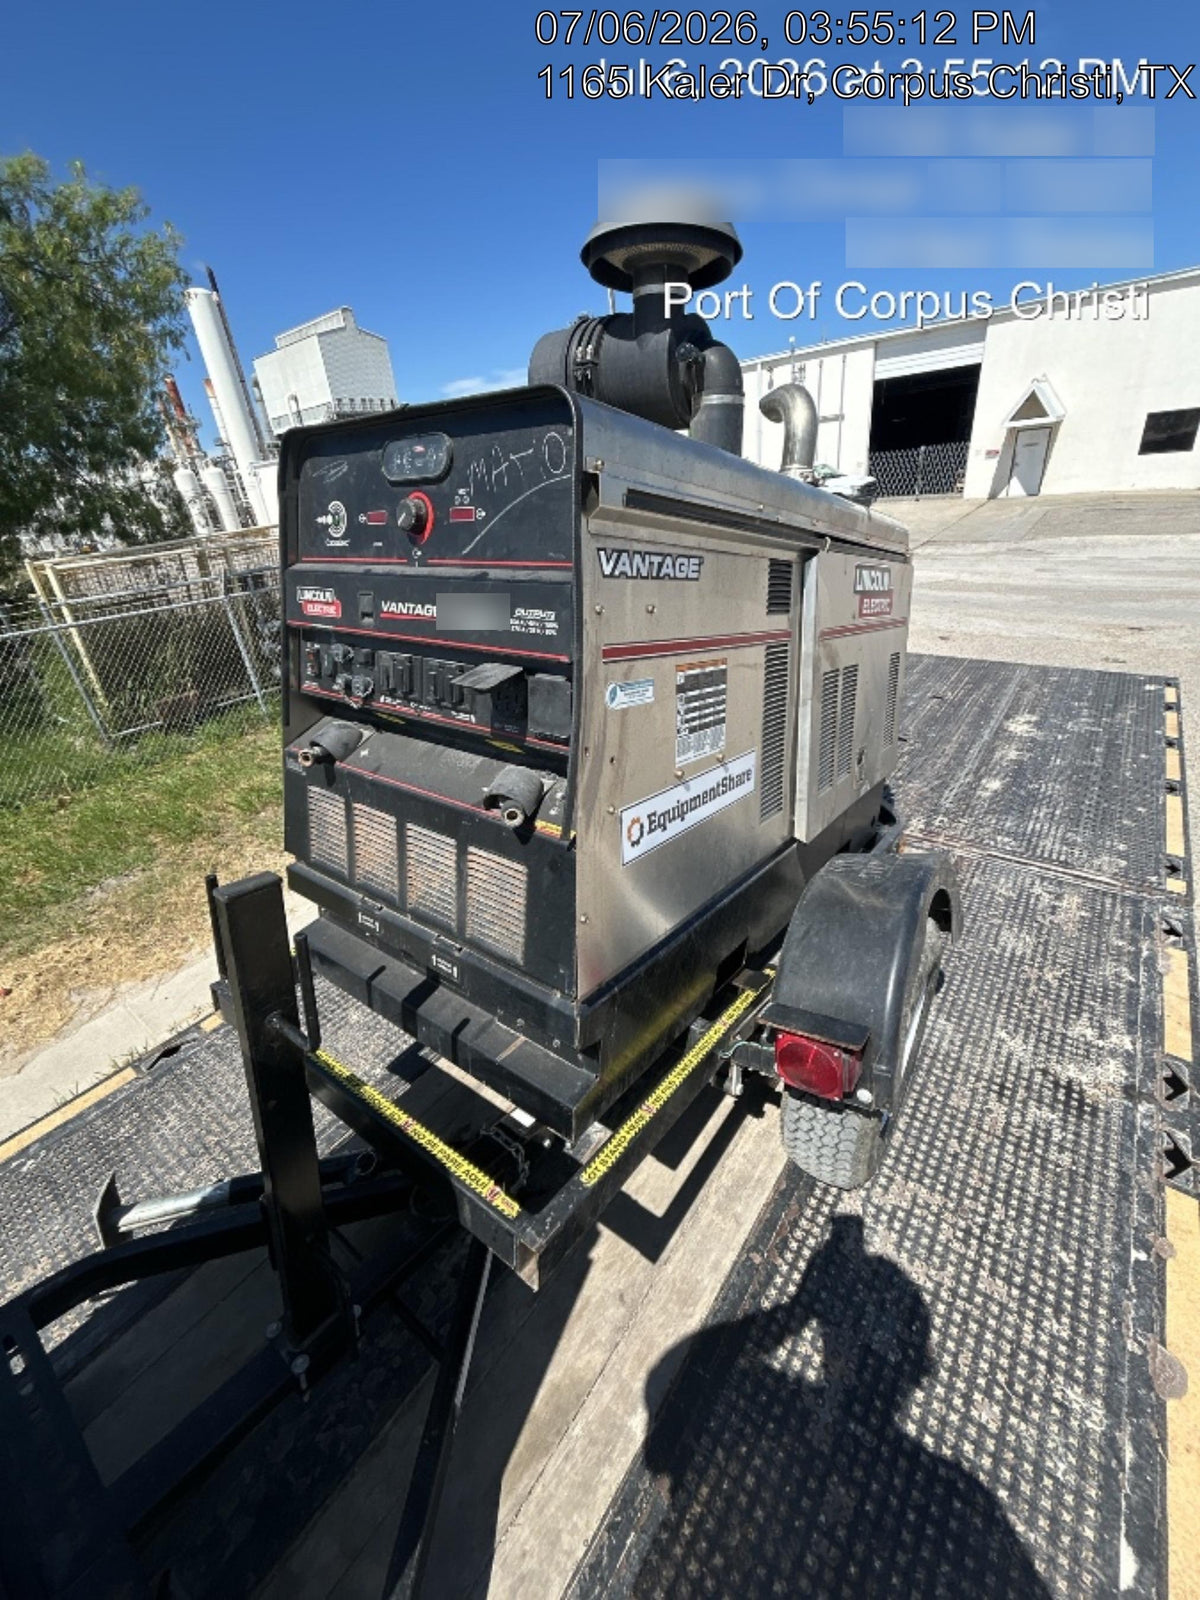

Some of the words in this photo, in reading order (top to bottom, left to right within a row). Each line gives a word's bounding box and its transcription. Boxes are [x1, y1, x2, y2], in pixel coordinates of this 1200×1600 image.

[598, 549, 701, 580] VANTAGE
[856, 567, 890, 591] LINCOLN
[299, 588, 334, 602] LINCOLN
[306, 603, 337, 614] ELECTRIC
[646, 768, 753, 836] EquipmentShare
[600, 1134, 628, 1167] STAND
